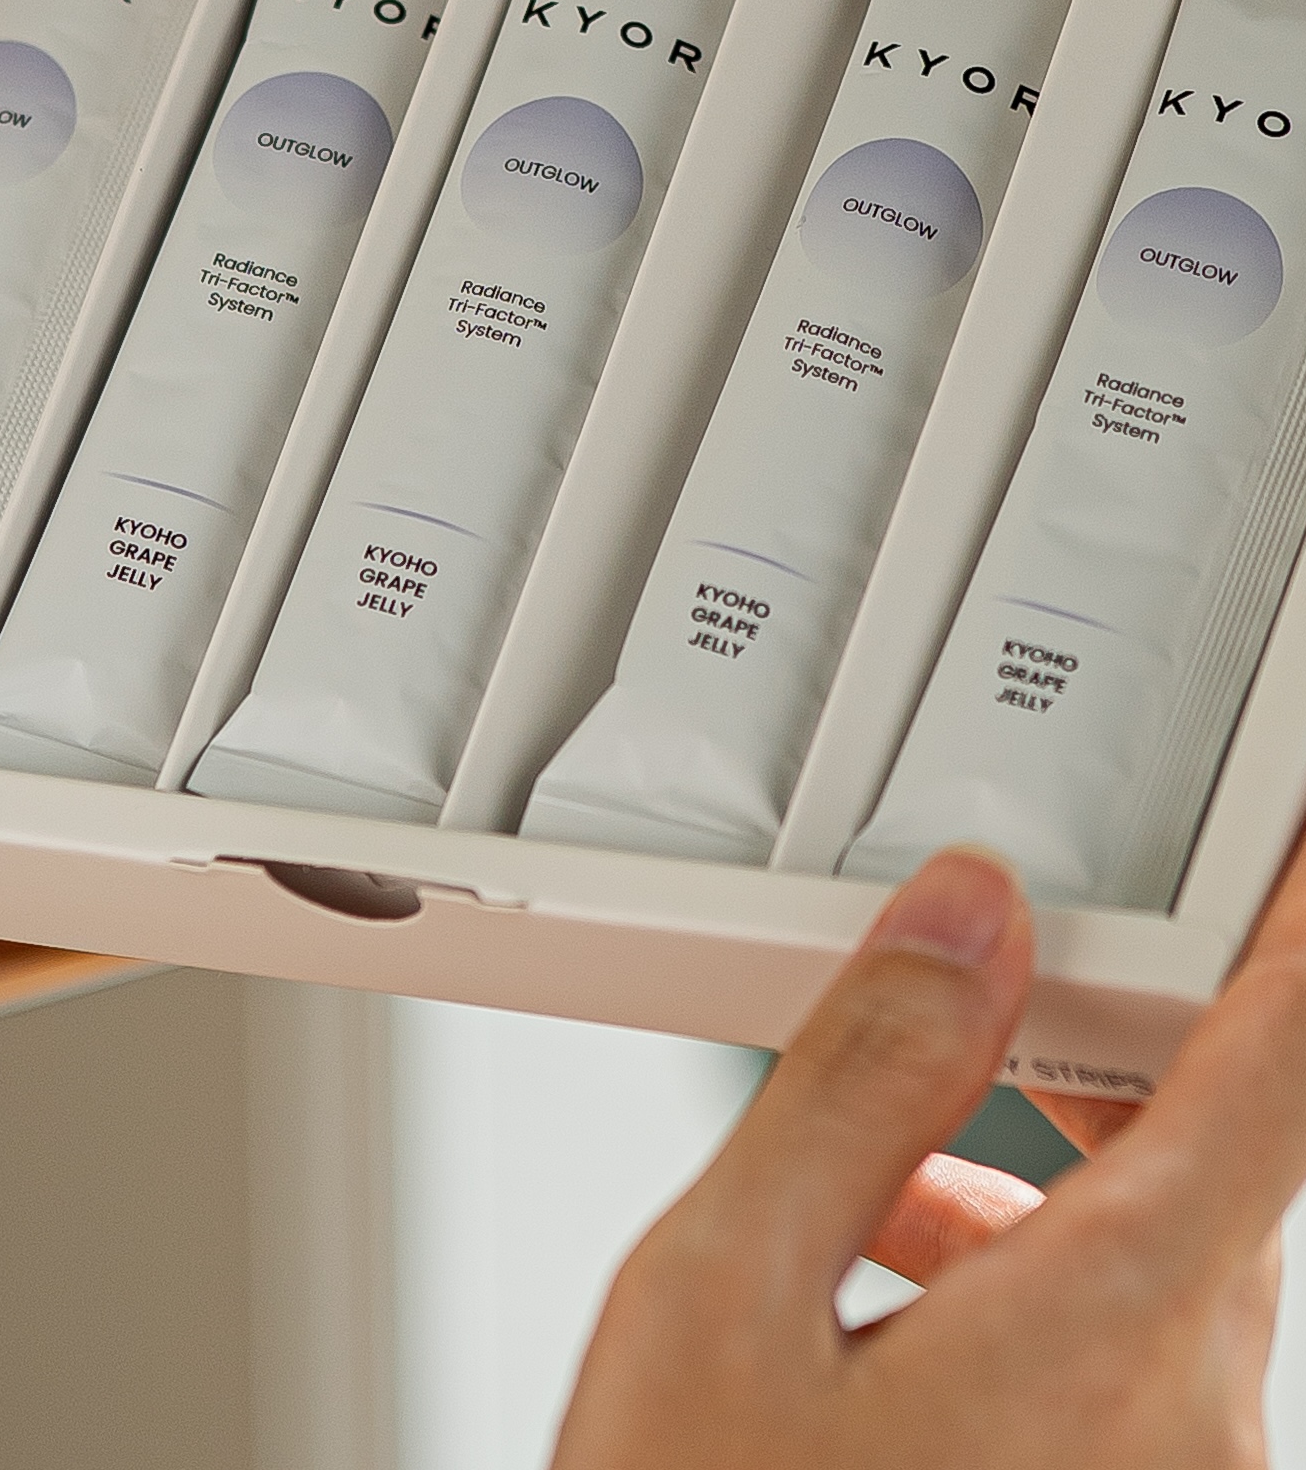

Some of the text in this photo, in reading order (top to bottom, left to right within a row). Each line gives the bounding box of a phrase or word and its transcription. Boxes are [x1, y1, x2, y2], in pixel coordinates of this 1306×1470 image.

[523, 0, 702, 73] KYOR
[864, 42, 1040, 119] KYOR
[258, 133, 353, 168] OUTGLOW
[505, 159, 599, 193] OUTGLOW
[843, 198, 938, 239] OUTGLOW
[213, 253, 297, 286] Radiance
[1141, 249, 1238, 285] OUTGLOW
[208, 293, 273, 321] System
[461, 281, 545, 313] Radiance
[456, 320, 521, 347] System
[797, 320, 881, 358] Radiance
[792, 359, 857, 391] System
[1097, 373, 1184, 407] Radiance
[1092, 414, 1159, 443] System
[115, 517, 187, 549] KYOHO
[110, 540, 177, 571] GRAPE
[364, 545, 437, 576] KYOHO
[107, 564, 162, 590] JELLY
[360, 569, 427, 598] GRAPE
[357, 593, 413, 617] JELLY
[696, 584, 770, 618] KYOHO
[691, 608, 759, 640] GRAPE
[688, 632, 745, 658] JELLY
[1003, 640, 1078, 672] KYOHO
[998, 665, 1066, 694] GRAPE
[996, 688, 1053, 712] JELLY
